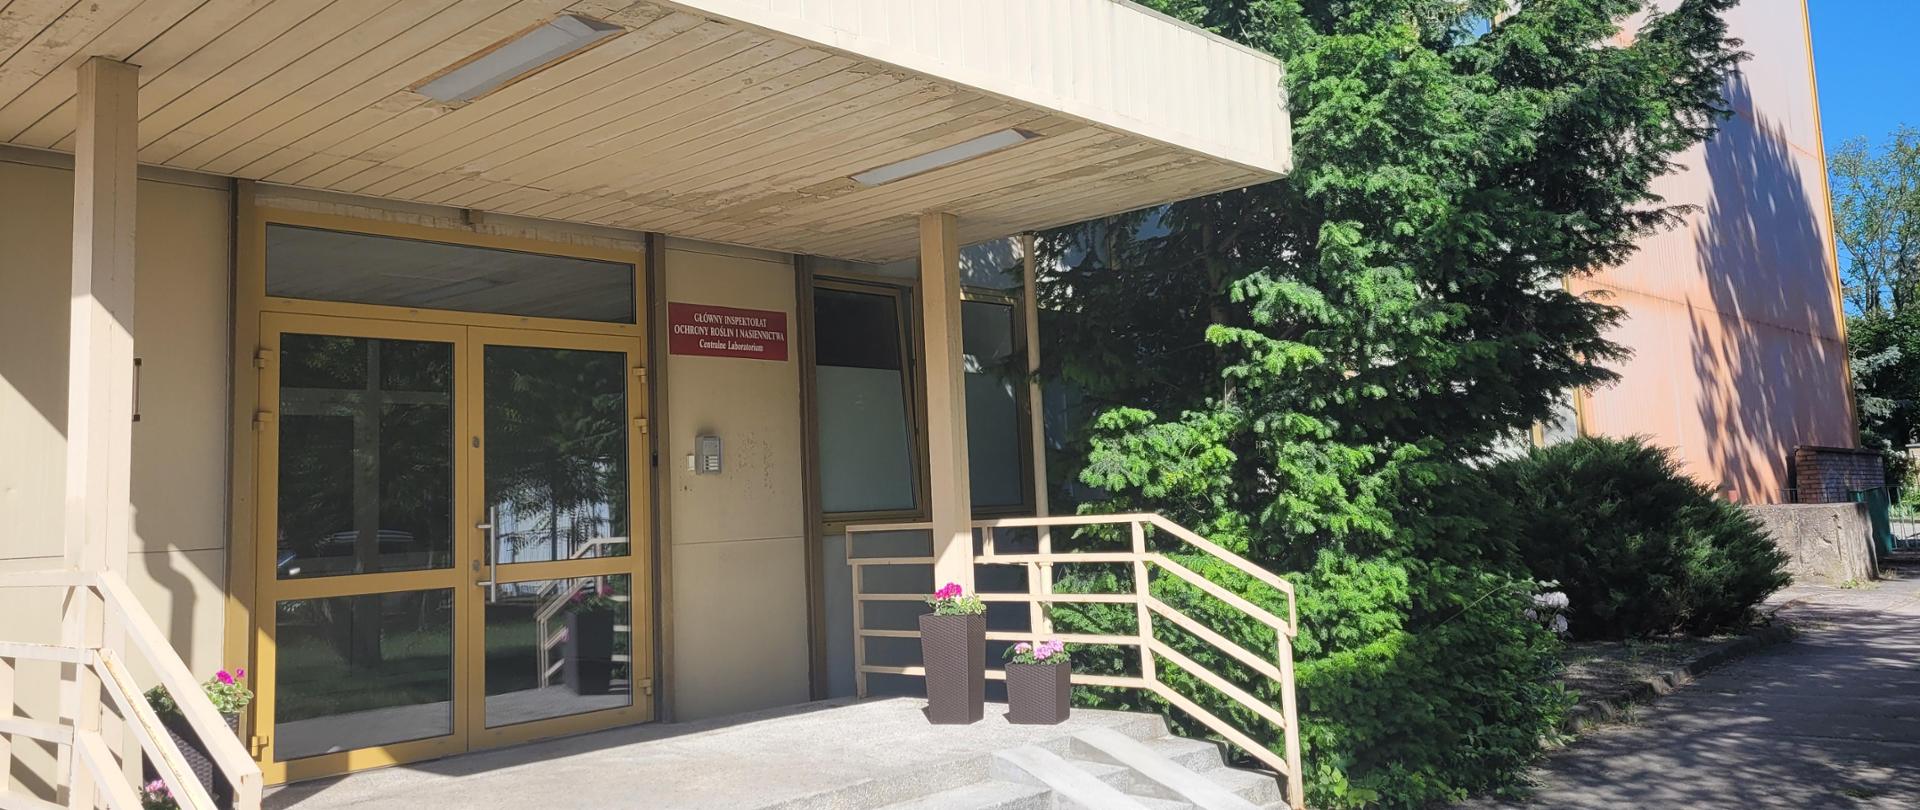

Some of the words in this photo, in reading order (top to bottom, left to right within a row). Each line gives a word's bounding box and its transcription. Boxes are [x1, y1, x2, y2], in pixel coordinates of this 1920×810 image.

[694, 312, 723, 324] GŁÓWNY
[724, 315, 767, 328] INSPEKTORAT
[674, 324, 709, 336] OCHRONY
[711, 324, 734, 337] ROŚLIN
[740, 329, 784, 341] NASIENNICTWA
[699, 339, 726, 349] Centralne
[728, 340, 764, 352] Laboratorium
